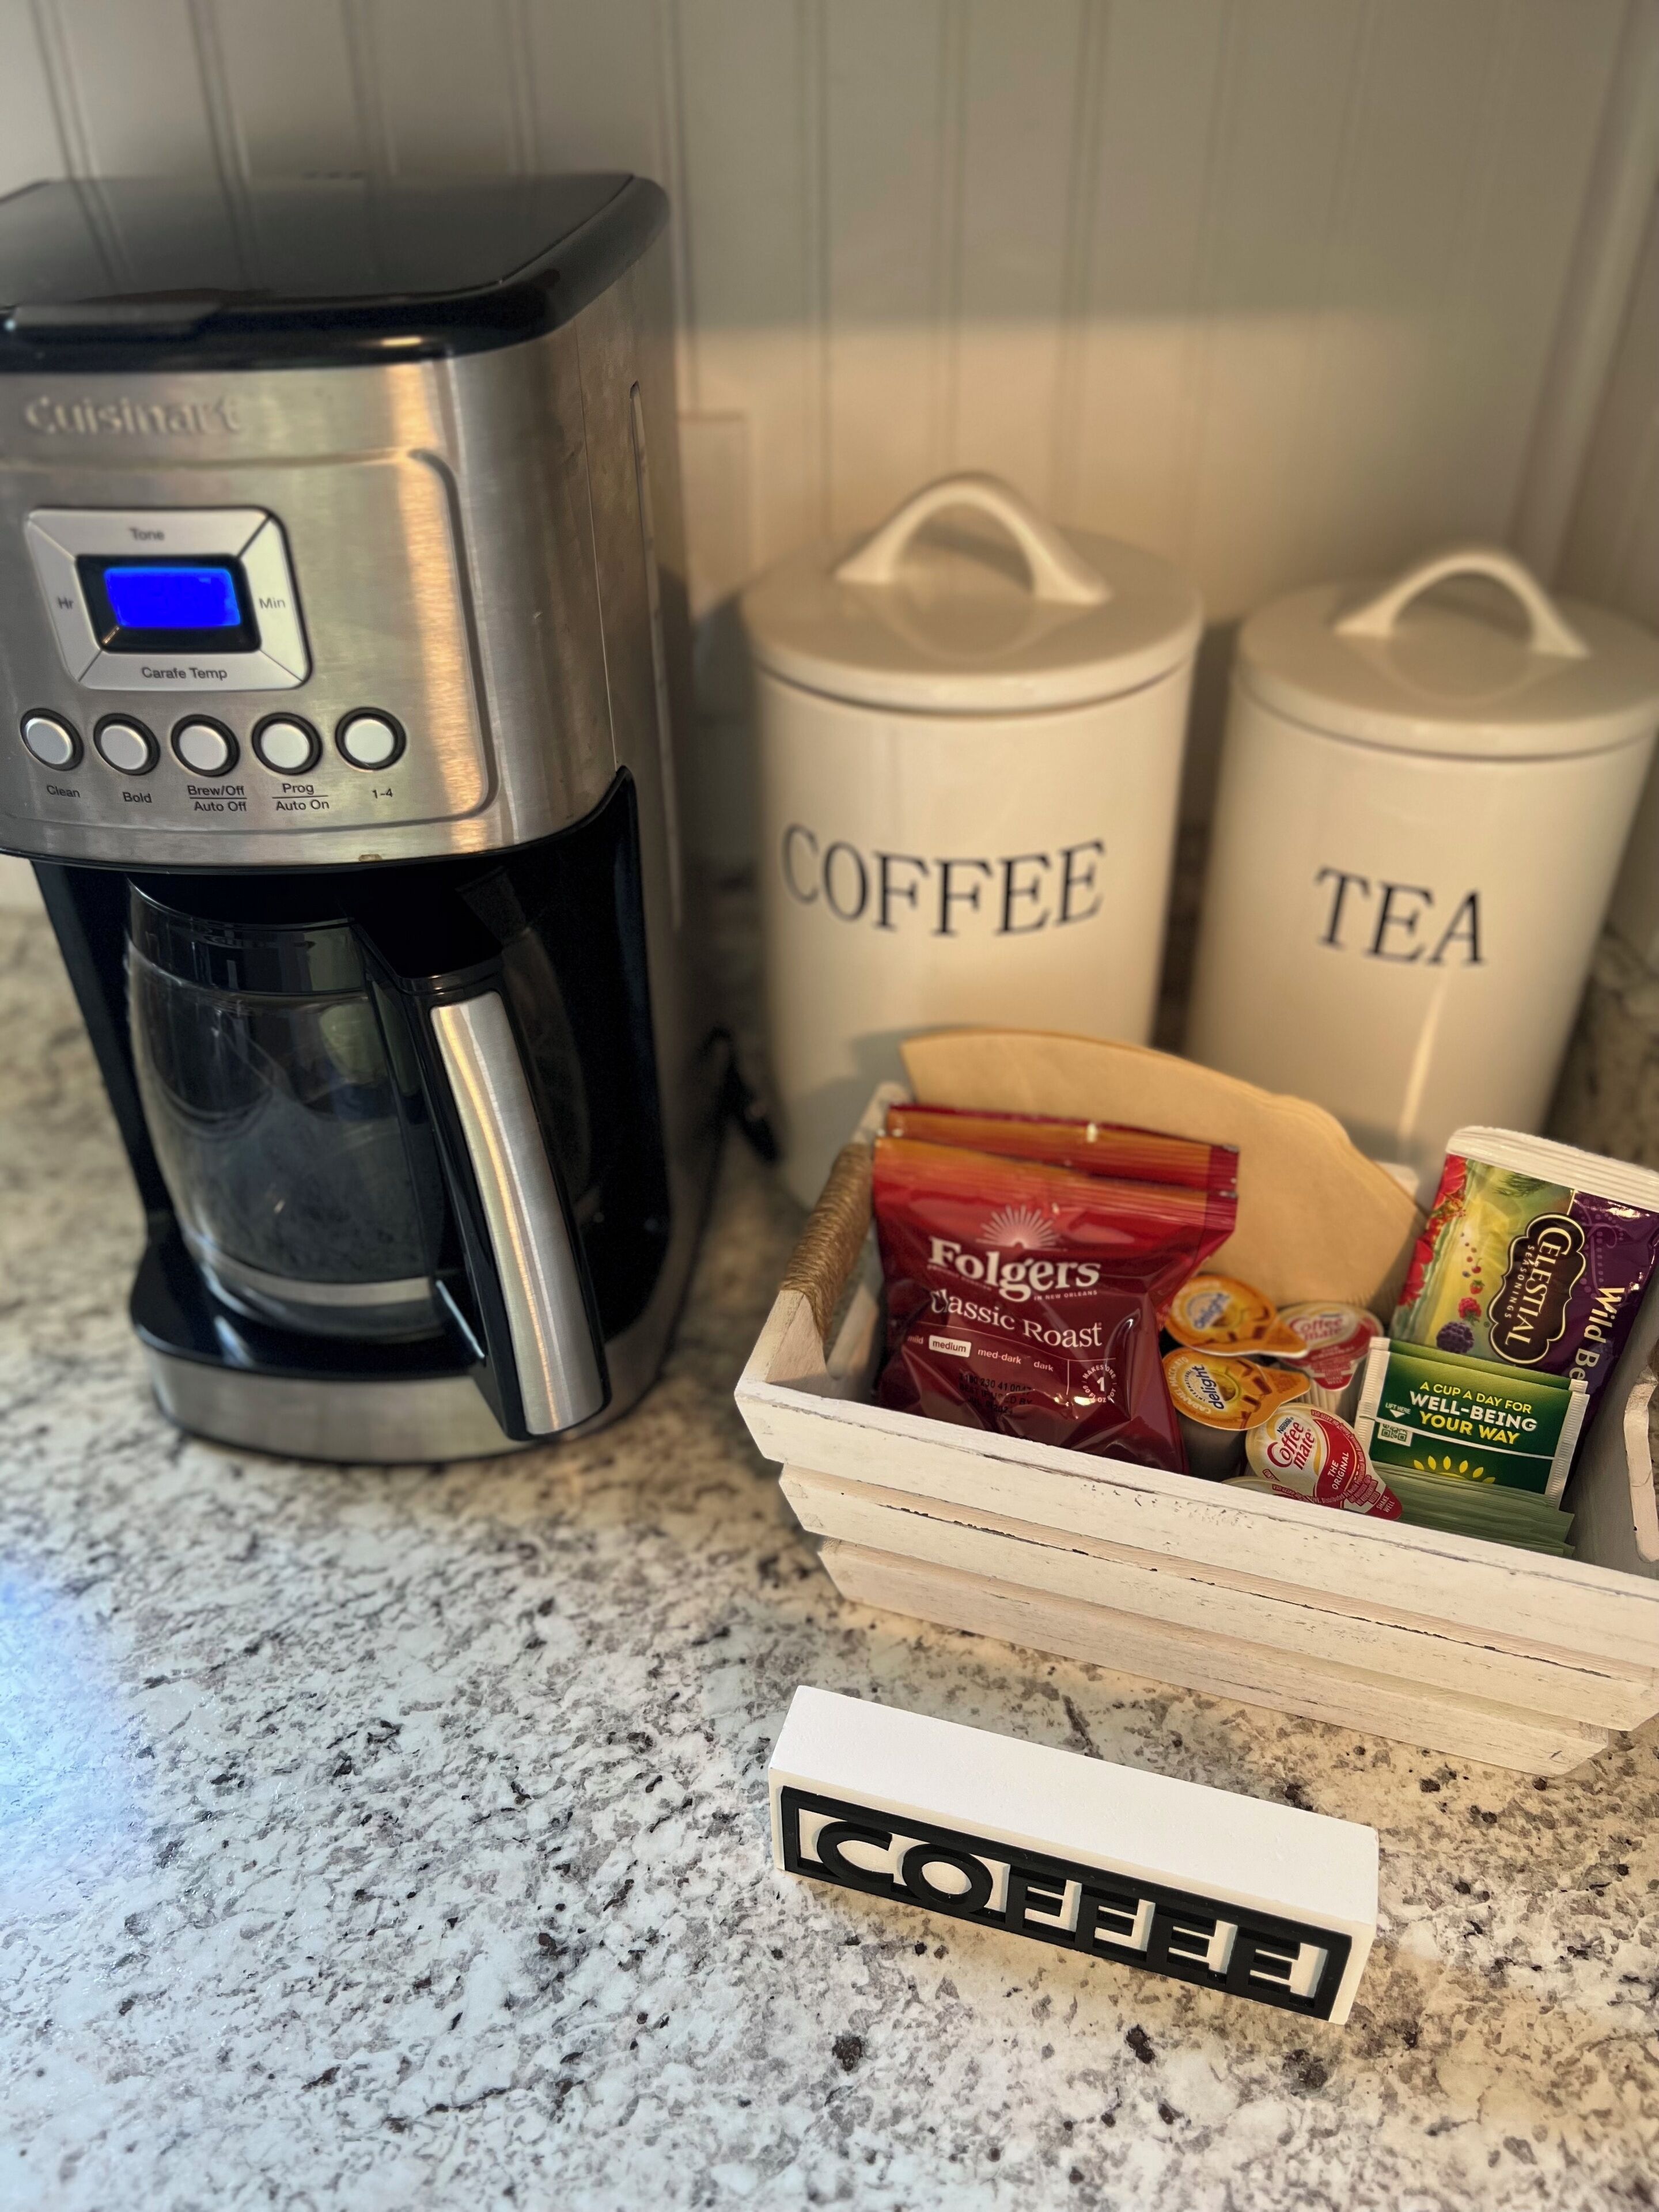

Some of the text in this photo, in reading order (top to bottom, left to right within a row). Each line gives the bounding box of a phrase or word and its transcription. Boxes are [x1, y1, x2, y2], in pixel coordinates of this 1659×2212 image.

[25, 395, 242, 434] Cuisinart
[130, 528, 165, 541] Tone
[58, 597, 74, 609] Hr
[259, 597, 286, 609] Min
[141, 666, 228, 681] Carafe Temp
[46, 785, 81, 798] Clean
[122, 791, 153, 804] Bold
[187, 784, 245, 797] Brew/Off
[282, 783, 315, 796] Prog
[372, 789, 393, 798] 1-4
[194, 801, 248, 812] Auto Off
[275, 799, 330, 811] Auto On
[782, 822, 1105, 937] COFFEE
[1315, 866, 1487, 967] TEA
[928, 1236, 1101, 1302] Folgers
[1504, 1244, 1535, 1319] SEASONINGS
[1505, 1226, 1572, 1346] CELESTIAL
[1063, 1290, 1098, 1299] ORLEANS
[930, 1288, 1103, 1348] Classic Roast
[1584, 1287, 1626, 1344] Wild
[907, 1335, 1054, 1372] mild medium med-dark dark
[1082, 1364, 1116, 1380] MAKES ONE
[998, 1380, 1008, 1391] 41
[1097, 1377, 1105, 1392] 1
[1192, 1363, 1225, 1410] delight
[1176, 1385, 1211, 1415] CARAMEL
[1419, 1381, 1532, 1414] A CUP A DAY FOR
[1385, 1402, 1411, 1415] LIFT HERE
[1409, 1390, 1538, 1432] WELL-BEING
[1419, 1410, 1520, 1445] YOUR WAY
[1267, 1422, 1304, 1468] Coffee
[1294, 1432, 1315, 1471] mate
[1327, 1459, 1339, 1478] THE
[1331, 1452, 1350, 1490] ORIGINAL
[1376, 1495, 1389, 1510] SHAKE
[1382, 1501, 1396, 1513] WELL
[817, 1820, 1316, 2009] COFFEE
